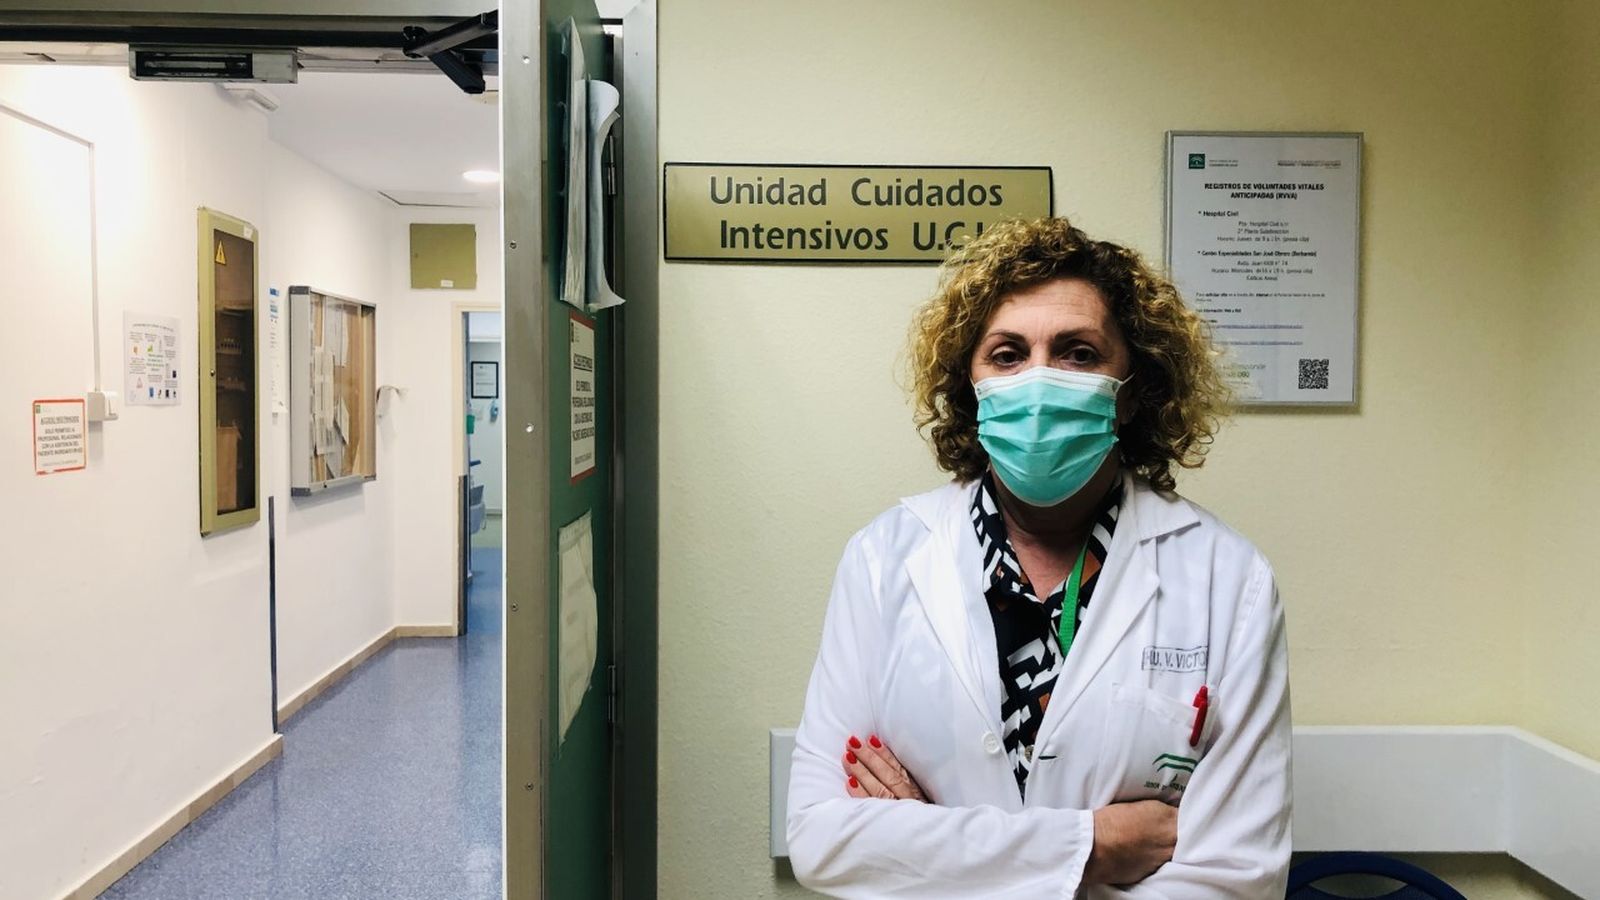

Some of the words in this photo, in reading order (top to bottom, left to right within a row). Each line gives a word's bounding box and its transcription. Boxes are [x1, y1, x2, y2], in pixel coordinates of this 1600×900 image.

[710, 176, 826, 205] Unidad
[851, 178, 1003, 206] Cuidados
[720, 220, 888, 250] Intensivos
[912, 221, 983, 250] U.CI
[1176, 651, 1206, 668] VICTO
